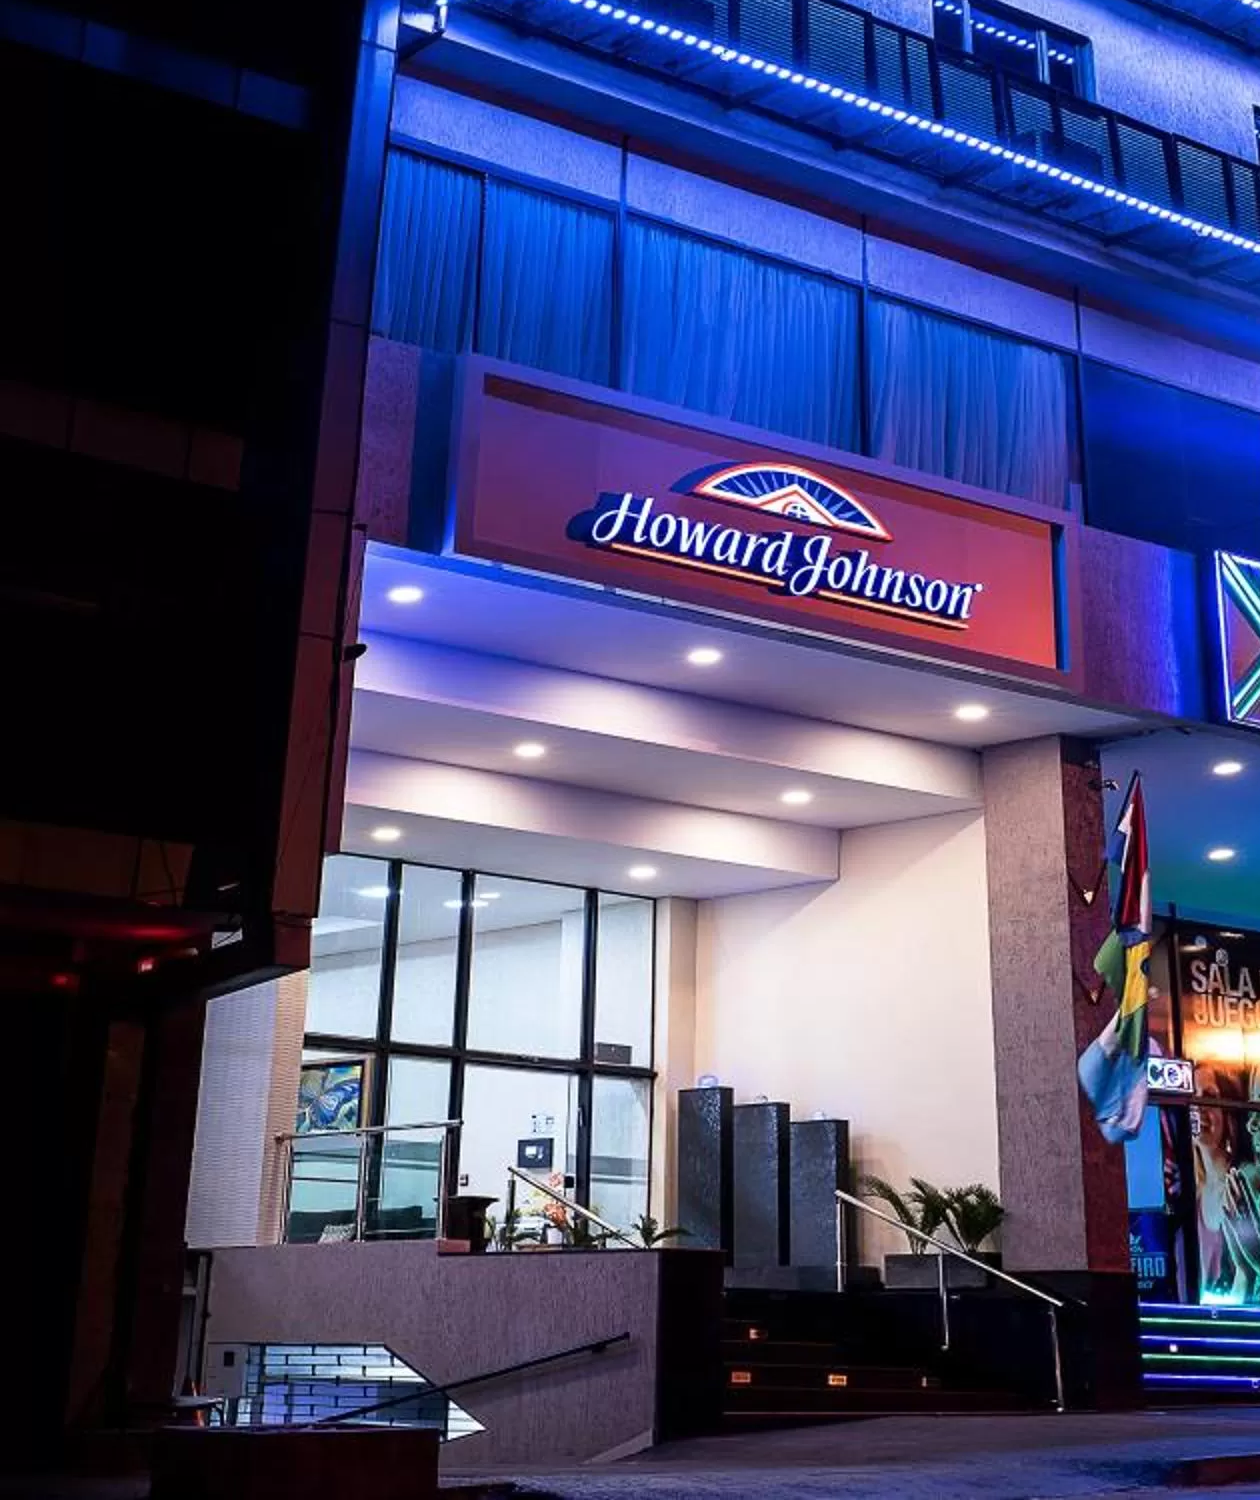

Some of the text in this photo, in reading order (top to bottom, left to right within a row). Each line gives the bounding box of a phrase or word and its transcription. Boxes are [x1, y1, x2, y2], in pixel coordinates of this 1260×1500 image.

[592, 491, 978, 619] Howard Johnson
[1190, 959, 1256, 999] SALA
